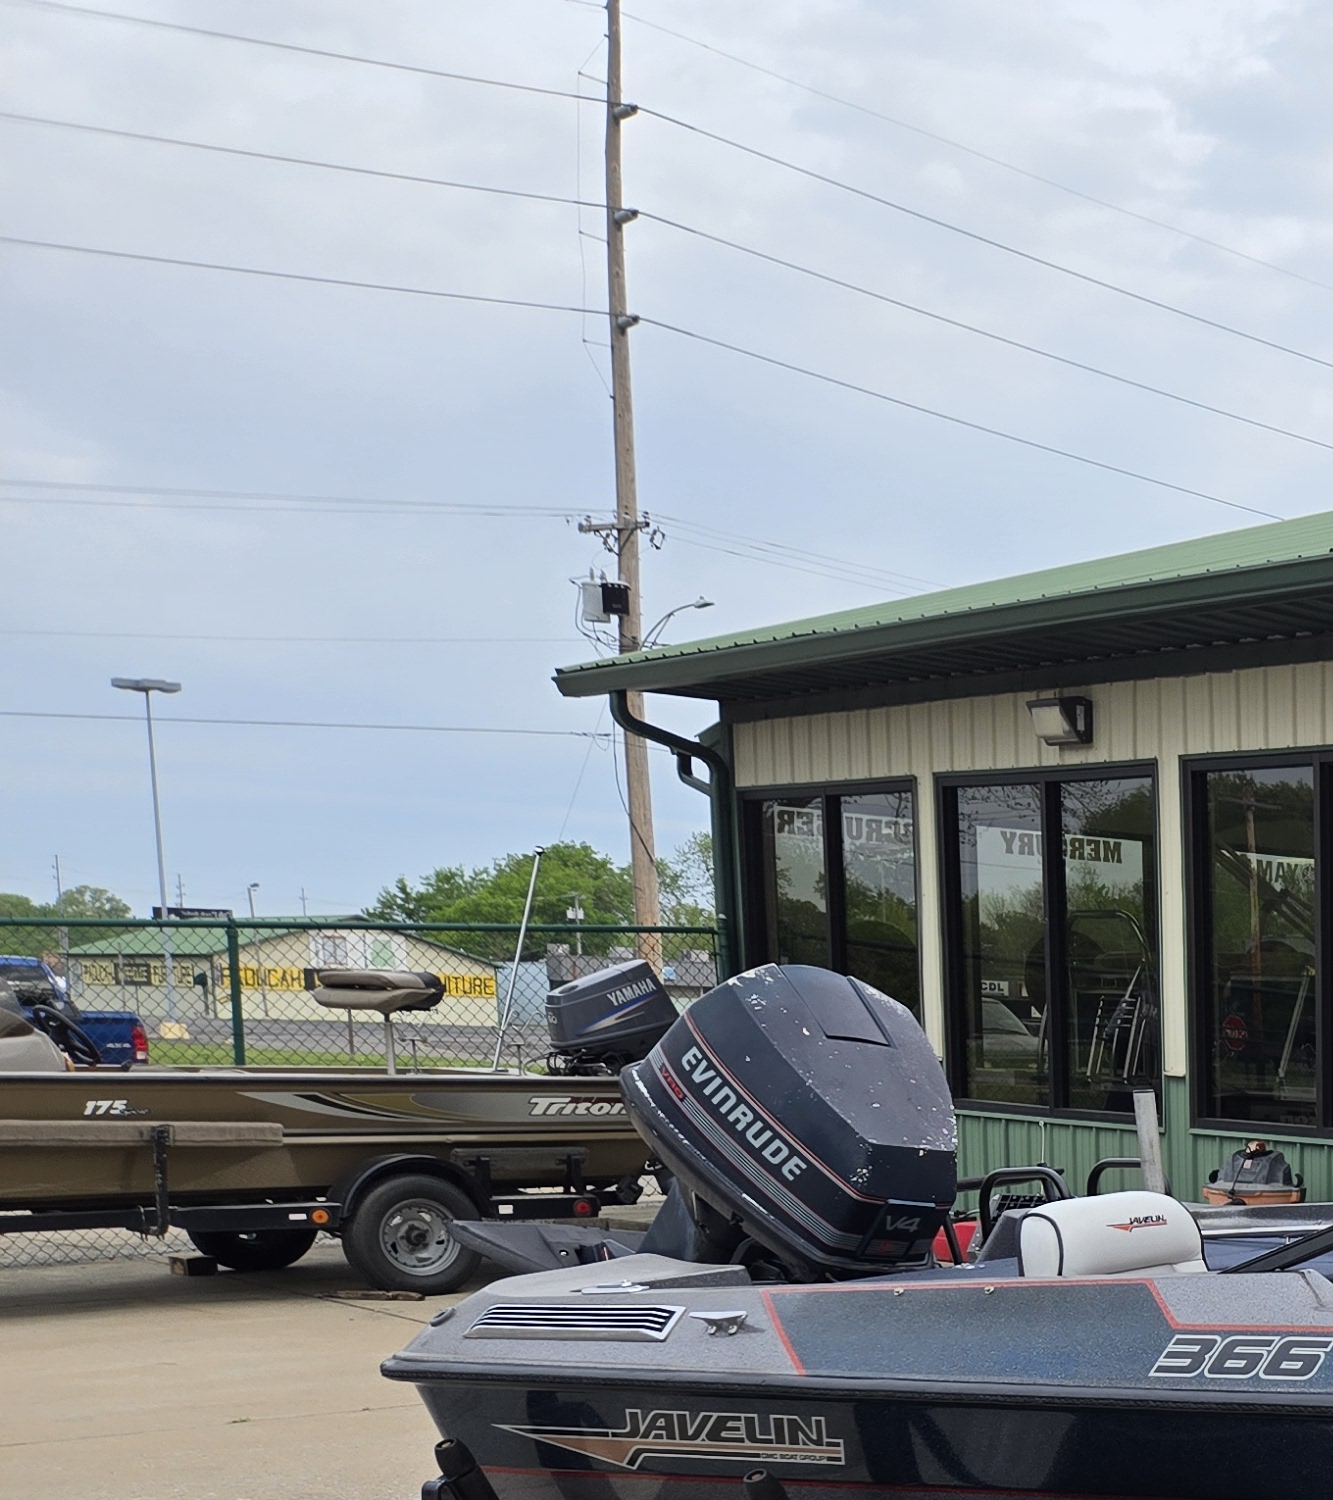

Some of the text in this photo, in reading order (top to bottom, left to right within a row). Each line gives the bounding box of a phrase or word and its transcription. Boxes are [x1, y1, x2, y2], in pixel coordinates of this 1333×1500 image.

[220, 967, 494, 995] PDUCAH ITURE
[606, 977, 657, 1006] YAMAHA
[83, 1099, 128, 1115] 175
[681, 1046, 807, 1181] EVINRUDE
[886, 1213, 921, 1232] V4
[1129, 1214, 1167, 1224] JAVELIN
[622, 1408, 844, 1447] JAVELIN
